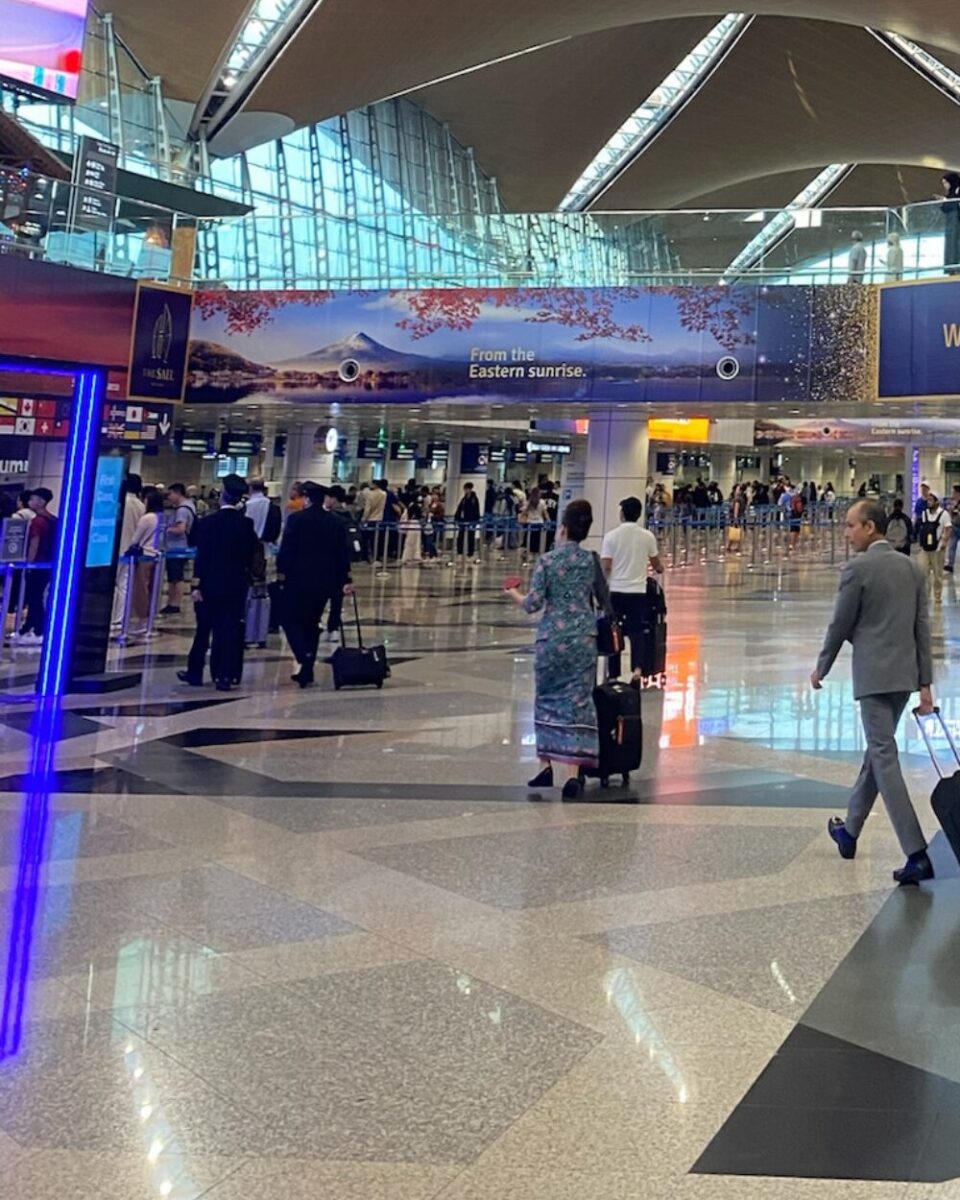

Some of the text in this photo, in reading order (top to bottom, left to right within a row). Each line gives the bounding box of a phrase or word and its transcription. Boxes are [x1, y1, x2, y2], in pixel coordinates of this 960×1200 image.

[470, 347, 535, 361] From the
[155, 367, 175, 382] SAIL
[469, 363, 587, 378] Eastern sunrise.
